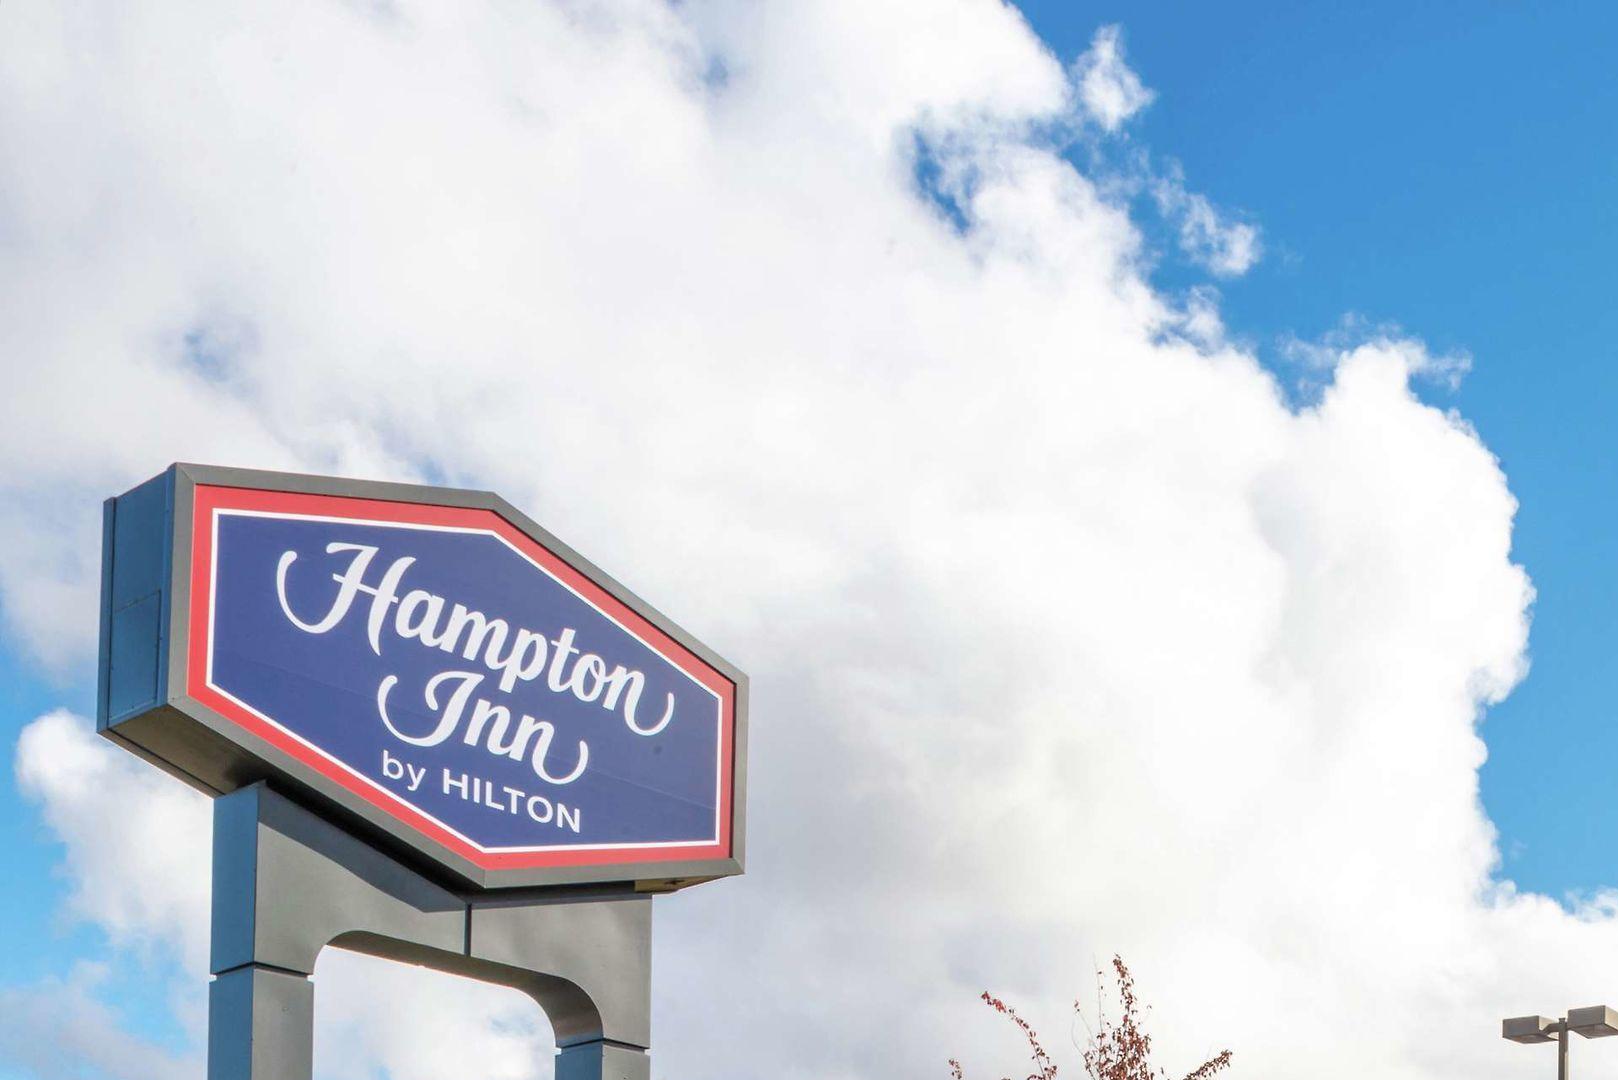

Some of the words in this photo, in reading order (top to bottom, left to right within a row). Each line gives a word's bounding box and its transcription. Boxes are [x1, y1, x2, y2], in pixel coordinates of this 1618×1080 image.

[276, 542, 675, 736] Hampton
[377, 670, 589, 785] Inn
[382, 749, 427, 791] by
[443, 768, 581, 833] HILTON
